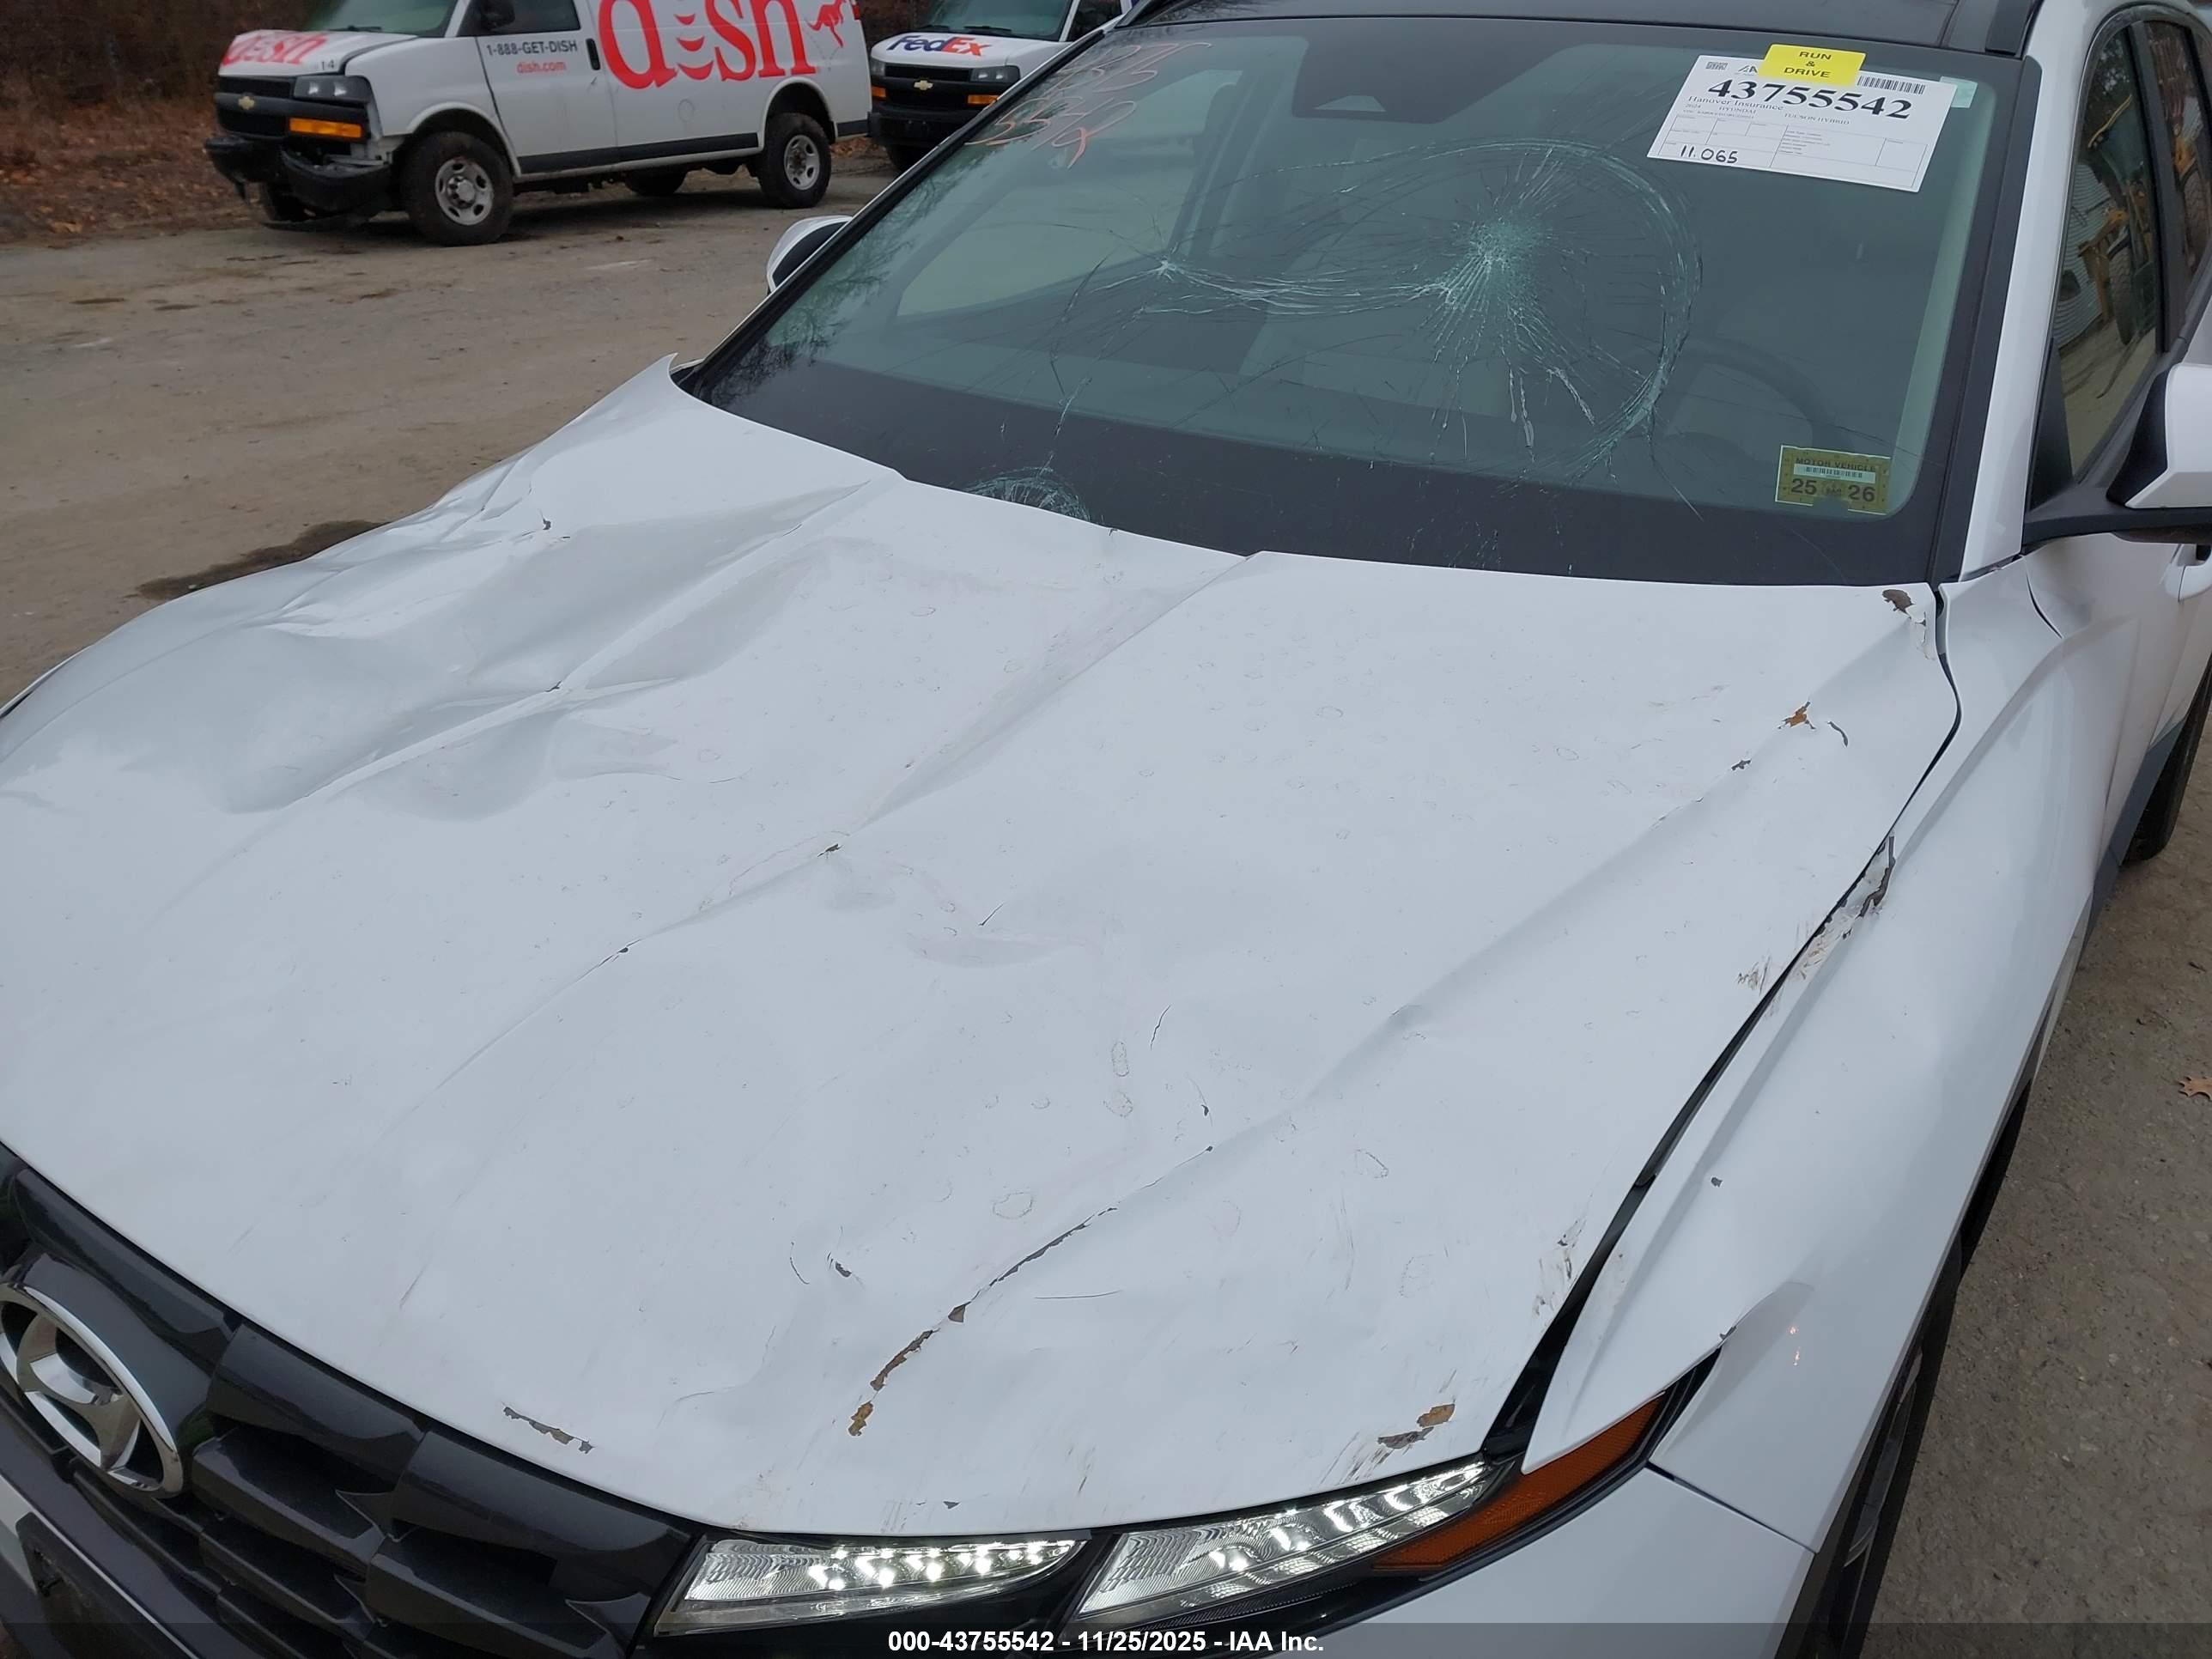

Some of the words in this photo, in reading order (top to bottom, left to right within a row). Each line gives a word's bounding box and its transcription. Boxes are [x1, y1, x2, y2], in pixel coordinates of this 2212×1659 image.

[486, 40, 578, 56] 1-888-GET-DISH
[886, 35, 992, 57] FedEx
[1799, 51, 1832, 61] RUN
[517, 61, 567, 74] dish.com
[1784, 67, 1832, 79] DRIVE
[1688, 95, 1732, 106] Hanover
[1734, 99, 1784, 111] Insurance
[1708, 78, 1912, 120] 43755542
[1791, 477, 1818, 495] 25
[1847, 484, 1876, 503] 26
